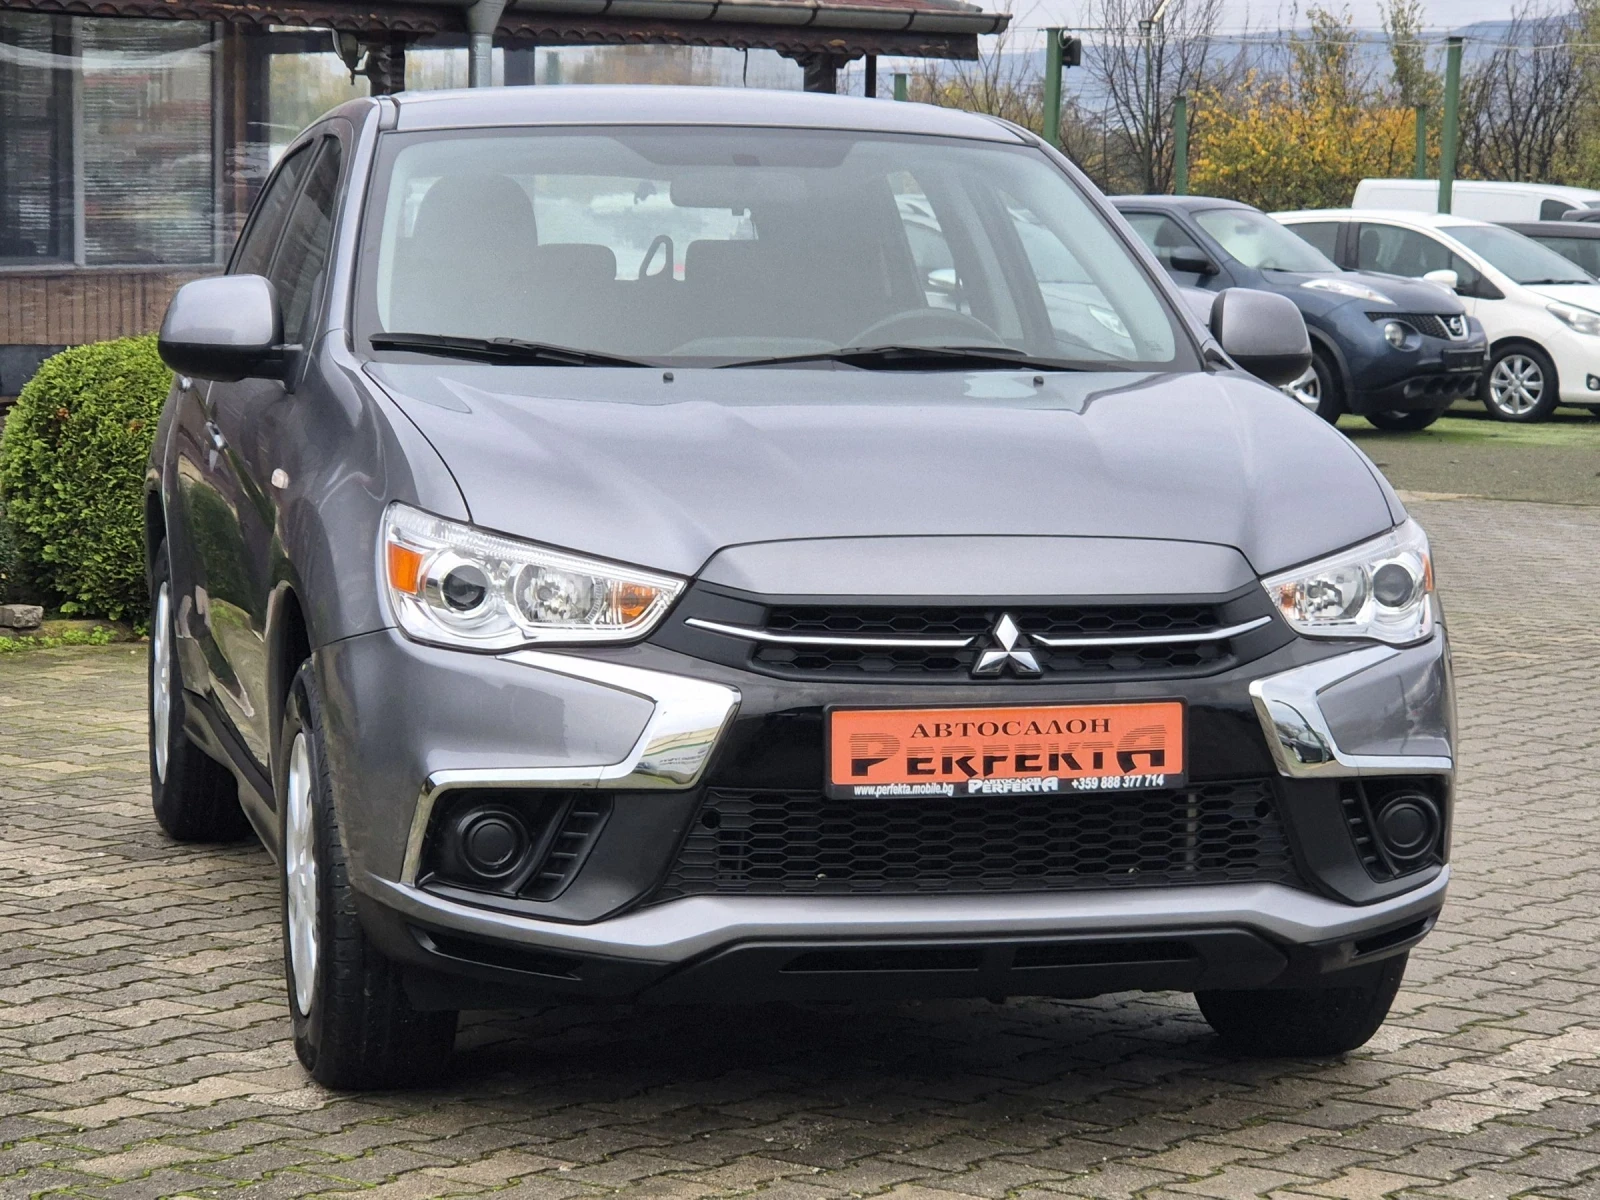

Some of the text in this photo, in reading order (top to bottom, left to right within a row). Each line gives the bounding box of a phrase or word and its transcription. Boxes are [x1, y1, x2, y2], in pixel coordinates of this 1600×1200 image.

[910, 718, 1112, 738] АВТОСАЛОН
[849, 724, 1167, 777] PERFEKTA
[854, 782, 954, 798] www.perfekta.mobile.bg
[967, 776, 1059, 794] PERFEKTA
[1071, 774, 1165, 790] +359 888 377 714
